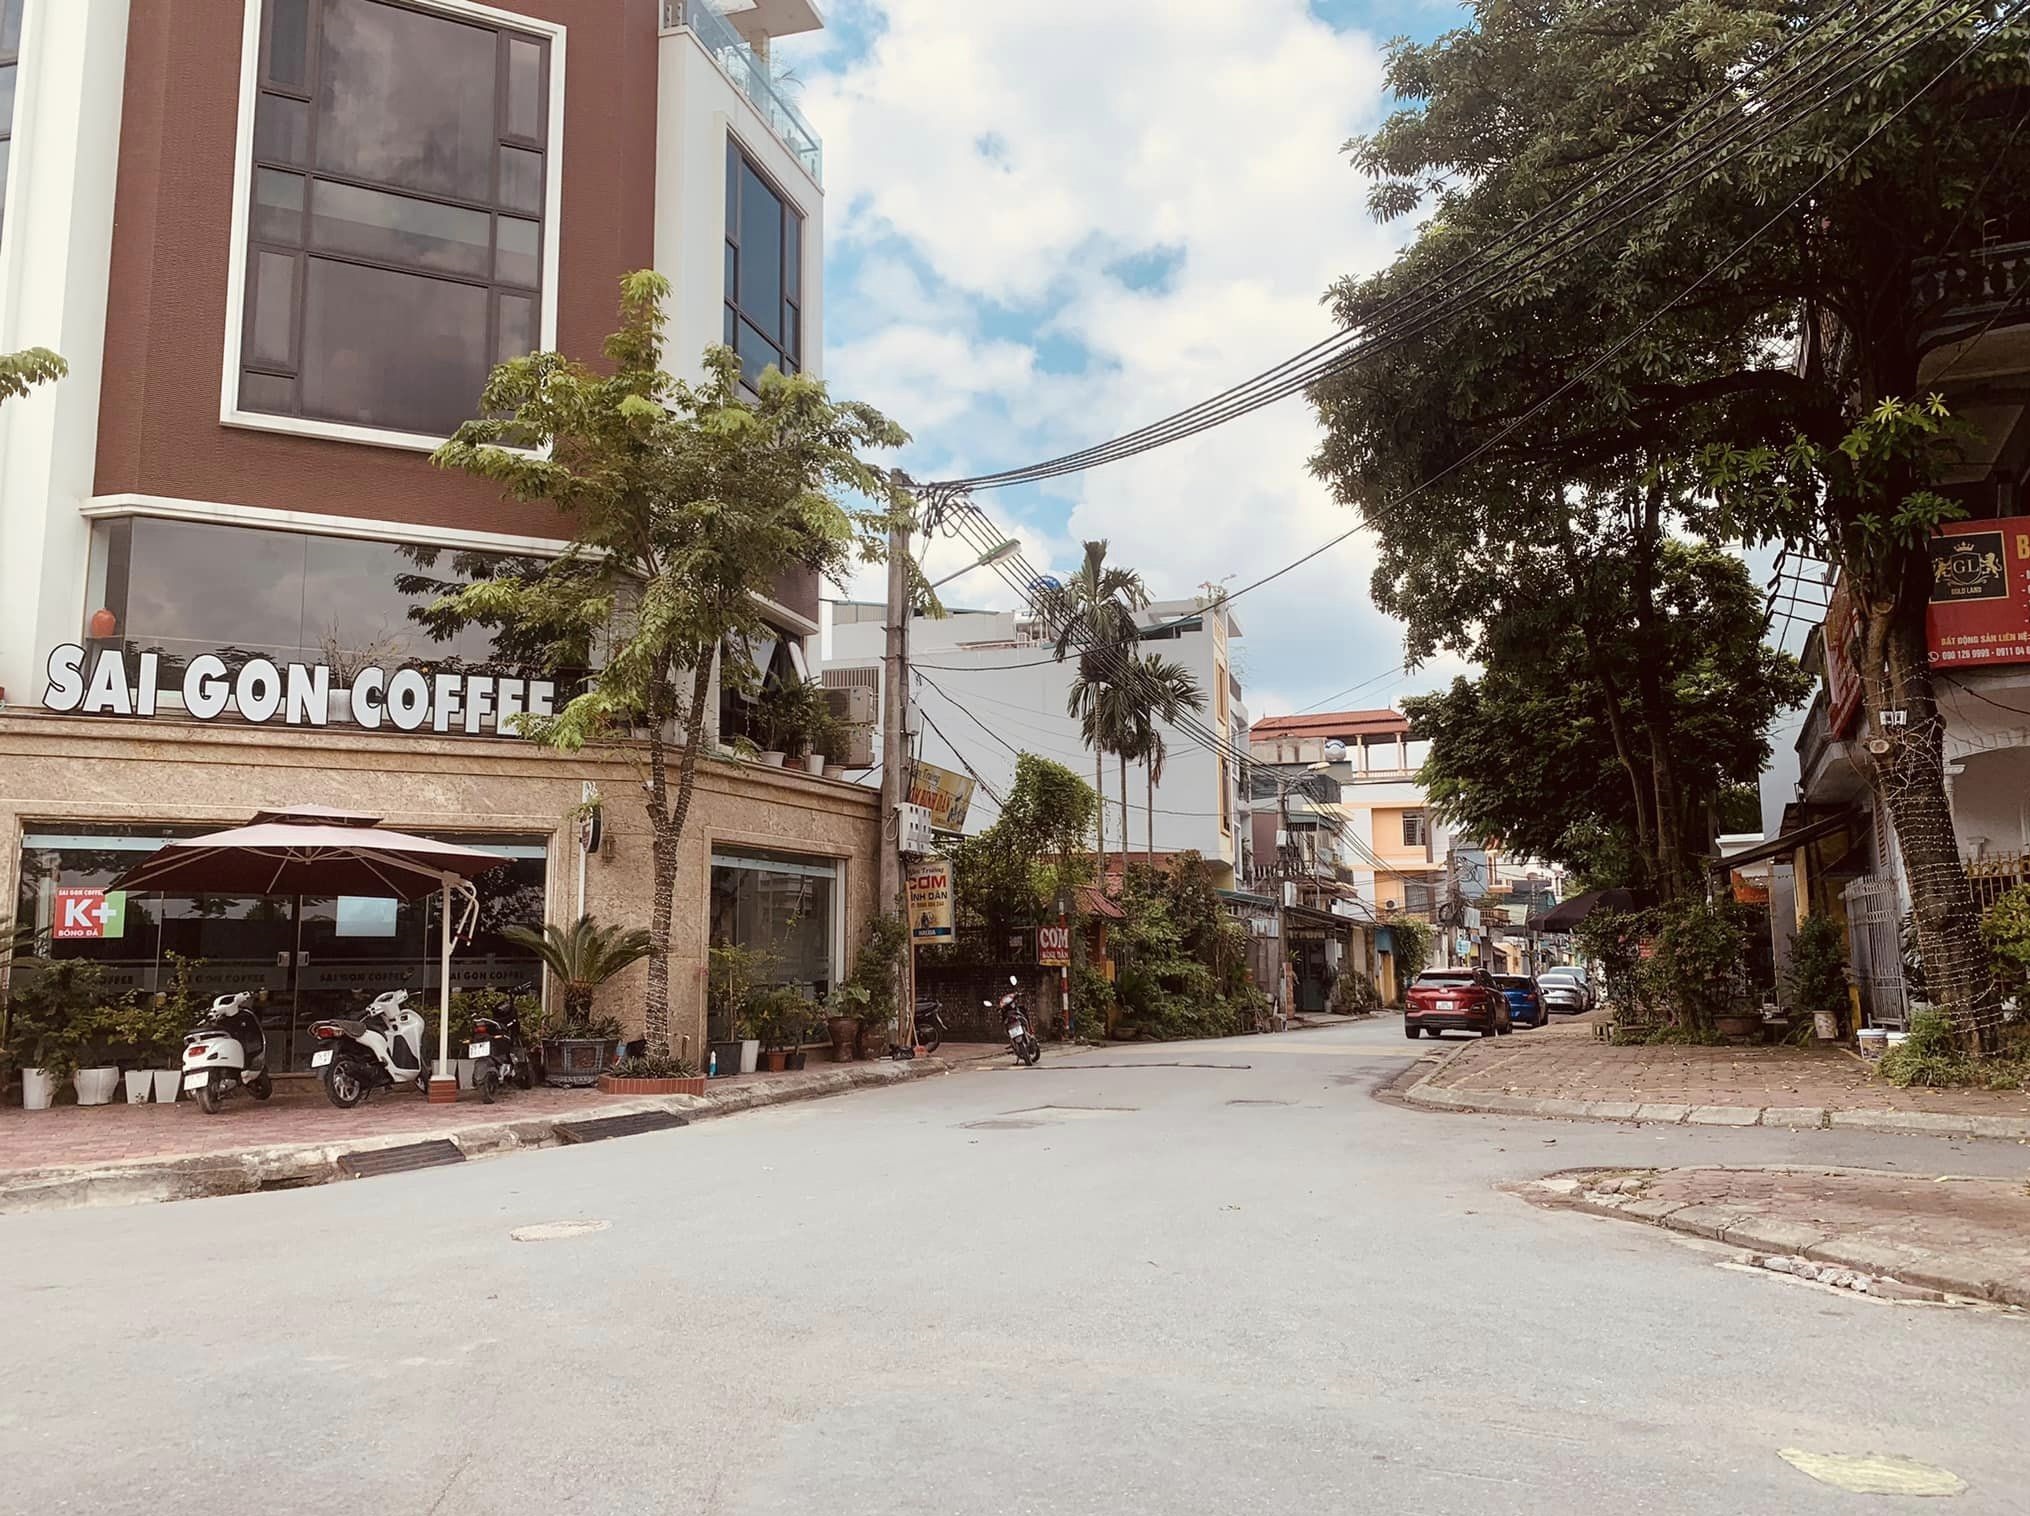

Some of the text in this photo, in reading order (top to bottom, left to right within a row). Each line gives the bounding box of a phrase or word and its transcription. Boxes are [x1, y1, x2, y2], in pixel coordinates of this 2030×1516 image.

[1952, 559, 1980, 575] GL
[1951, 586, 1982, 595] GOLD LAND
[42, 643, 158, 717] SAI
[182, 654, 329, 726] GON
[64, 898, 117, 927] K+
